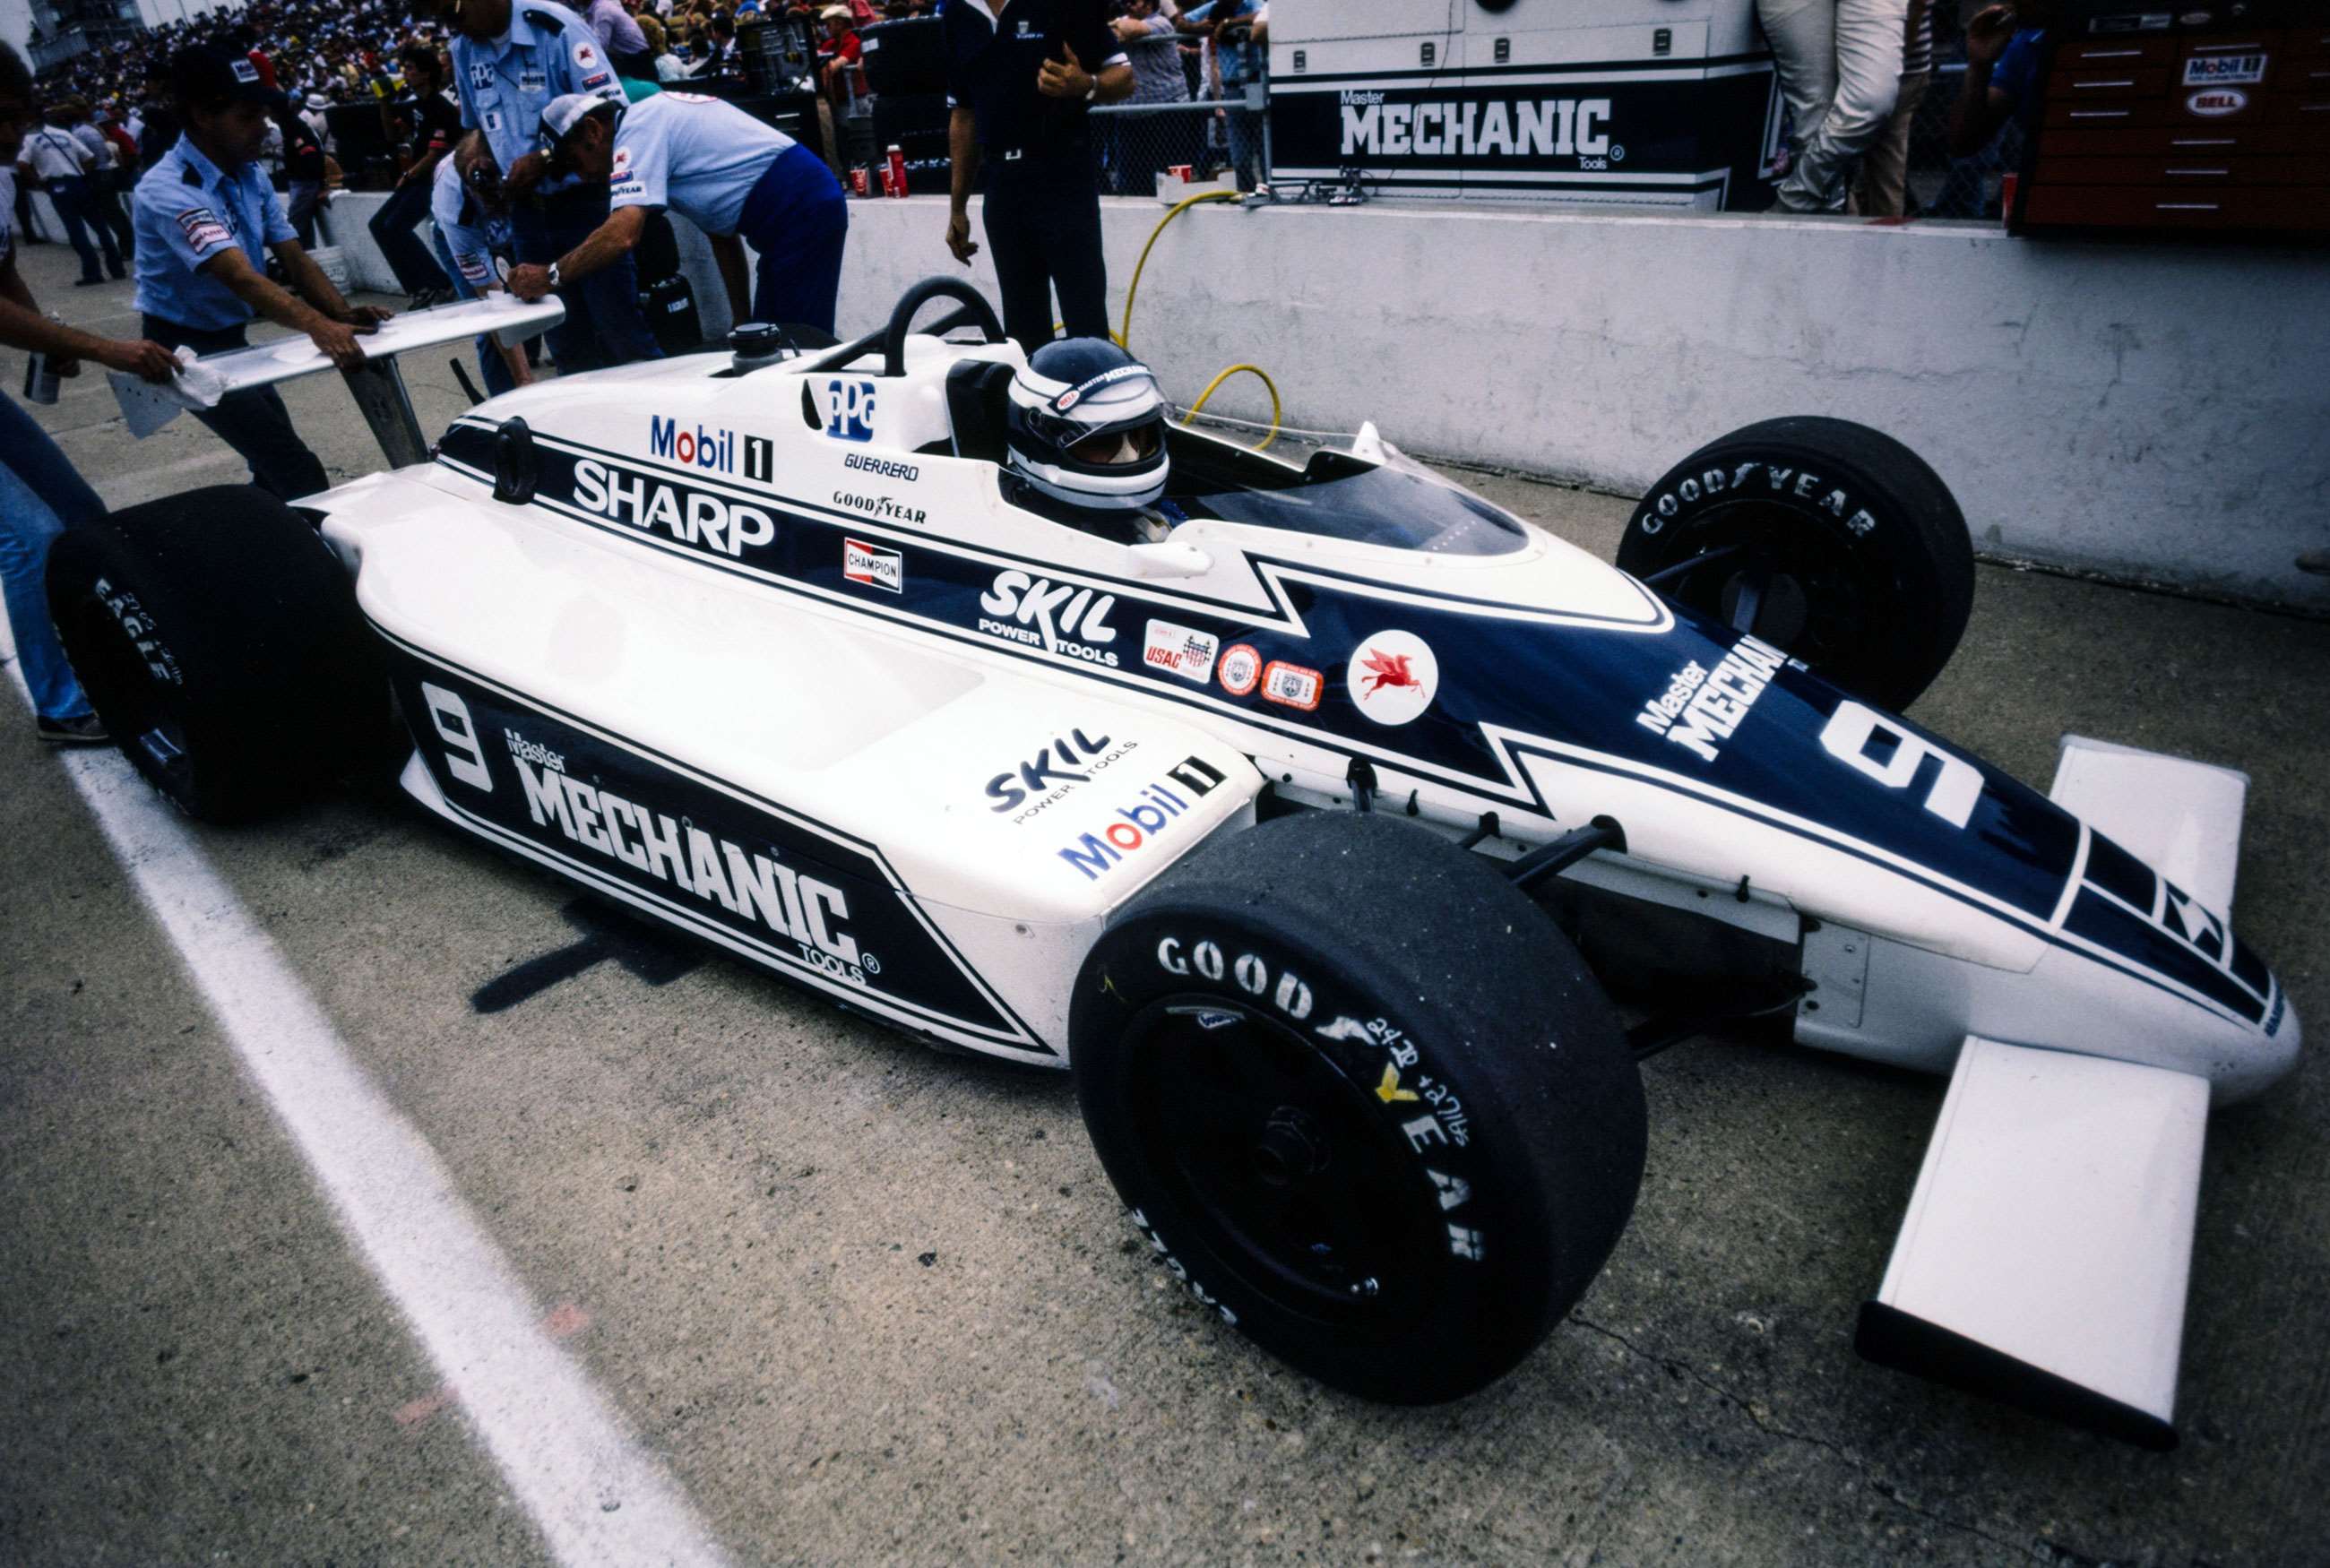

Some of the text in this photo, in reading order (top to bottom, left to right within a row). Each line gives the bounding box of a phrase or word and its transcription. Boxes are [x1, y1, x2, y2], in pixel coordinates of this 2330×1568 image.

[1341, 90, 1385, 106] Master
[1341, 99, 1610, 156] MECHANIC
[2196, 95, 2238, 110] BELL
[1578, 156, 1608, 170] Tools
[651, 415, 771, 482] Mobil 1
[844, 453, 919, 482] GUERRERO
[574, 460, 775, 556] SHARP
[848, 554, 897, 578] CHAMPION
[979, 618, 1118, 668] POWER TOOLS
[980, 571, 1117, 653] SKIL
[1146, 646, 1183, 669] USAC
[1635, 659, 1708, 735] Master
[422, 682, 493, 793] 9
[504, 728, 566, 774] Master
[1819, 699, 1986, 830] 9
[985, 728, 1111, 814] SKIL
[1014, 740, 1139, 825] POWER TOOLS
[513, 757, 862, 968] MECHANIC
[1057, 782, 1190, 882] Mobil
[798, 943, 867, 986] TOOLS
